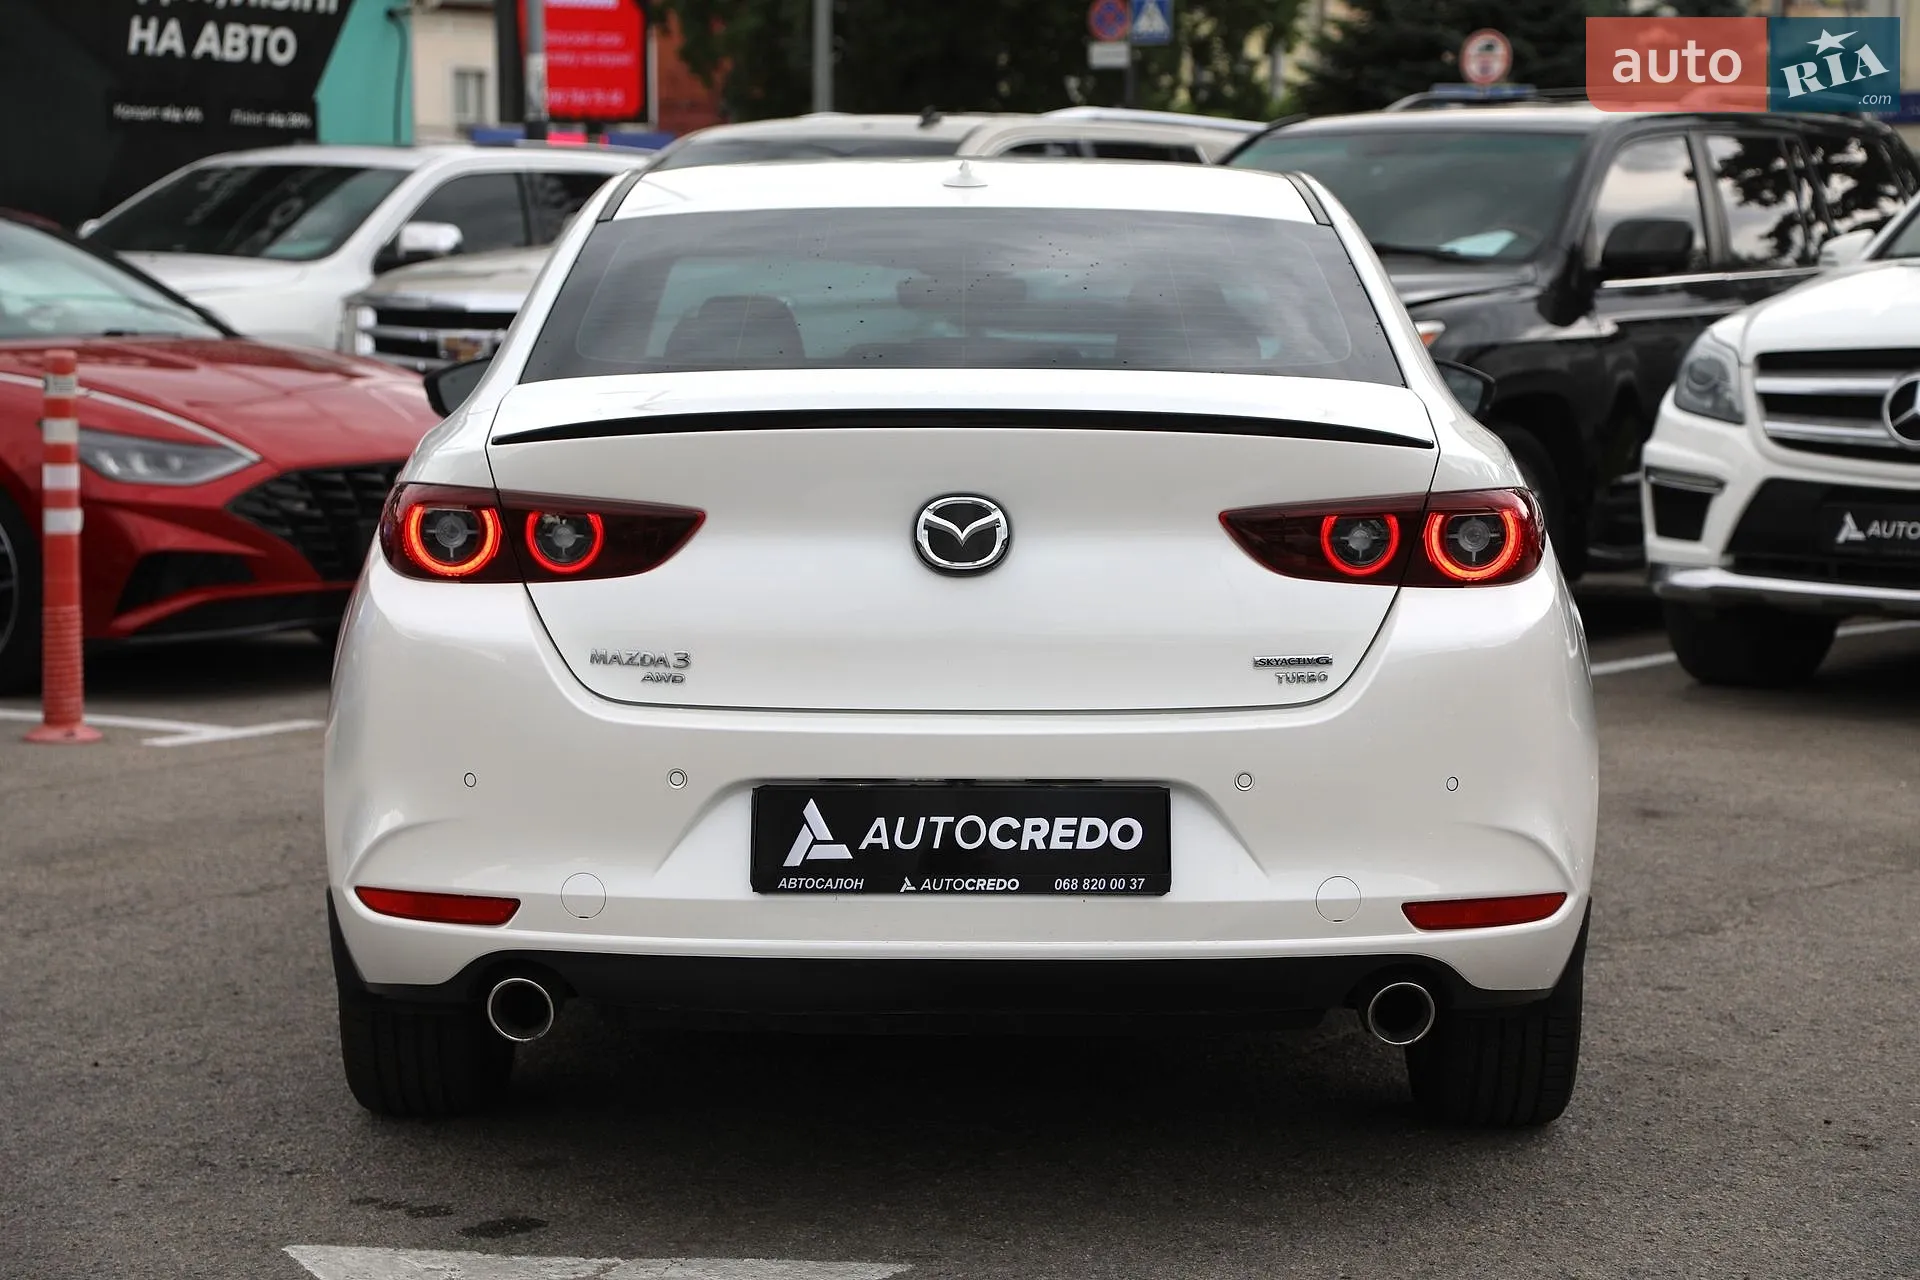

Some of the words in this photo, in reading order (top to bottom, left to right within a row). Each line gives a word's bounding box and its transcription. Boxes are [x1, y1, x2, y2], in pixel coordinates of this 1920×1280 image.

[128, 14, 186, 58] НА
[192, 20, 298, 67] АВТО
[641, 671, 686, 684] AWD
[1275, 671, 1328, 684] TURBO
[859, 814, 1143, 850] AUTOCREDO
[778, 877, 865, 891] АВТОСАЛОН
[920, 878, 1020, 892] AUTOCREDO
[1054, 878, 1080, 892] 068
[1082, 878, 1107, 892] 820
[1109, 878, 1127, 891] 00
[1129, 877, 1146, 891] 37
